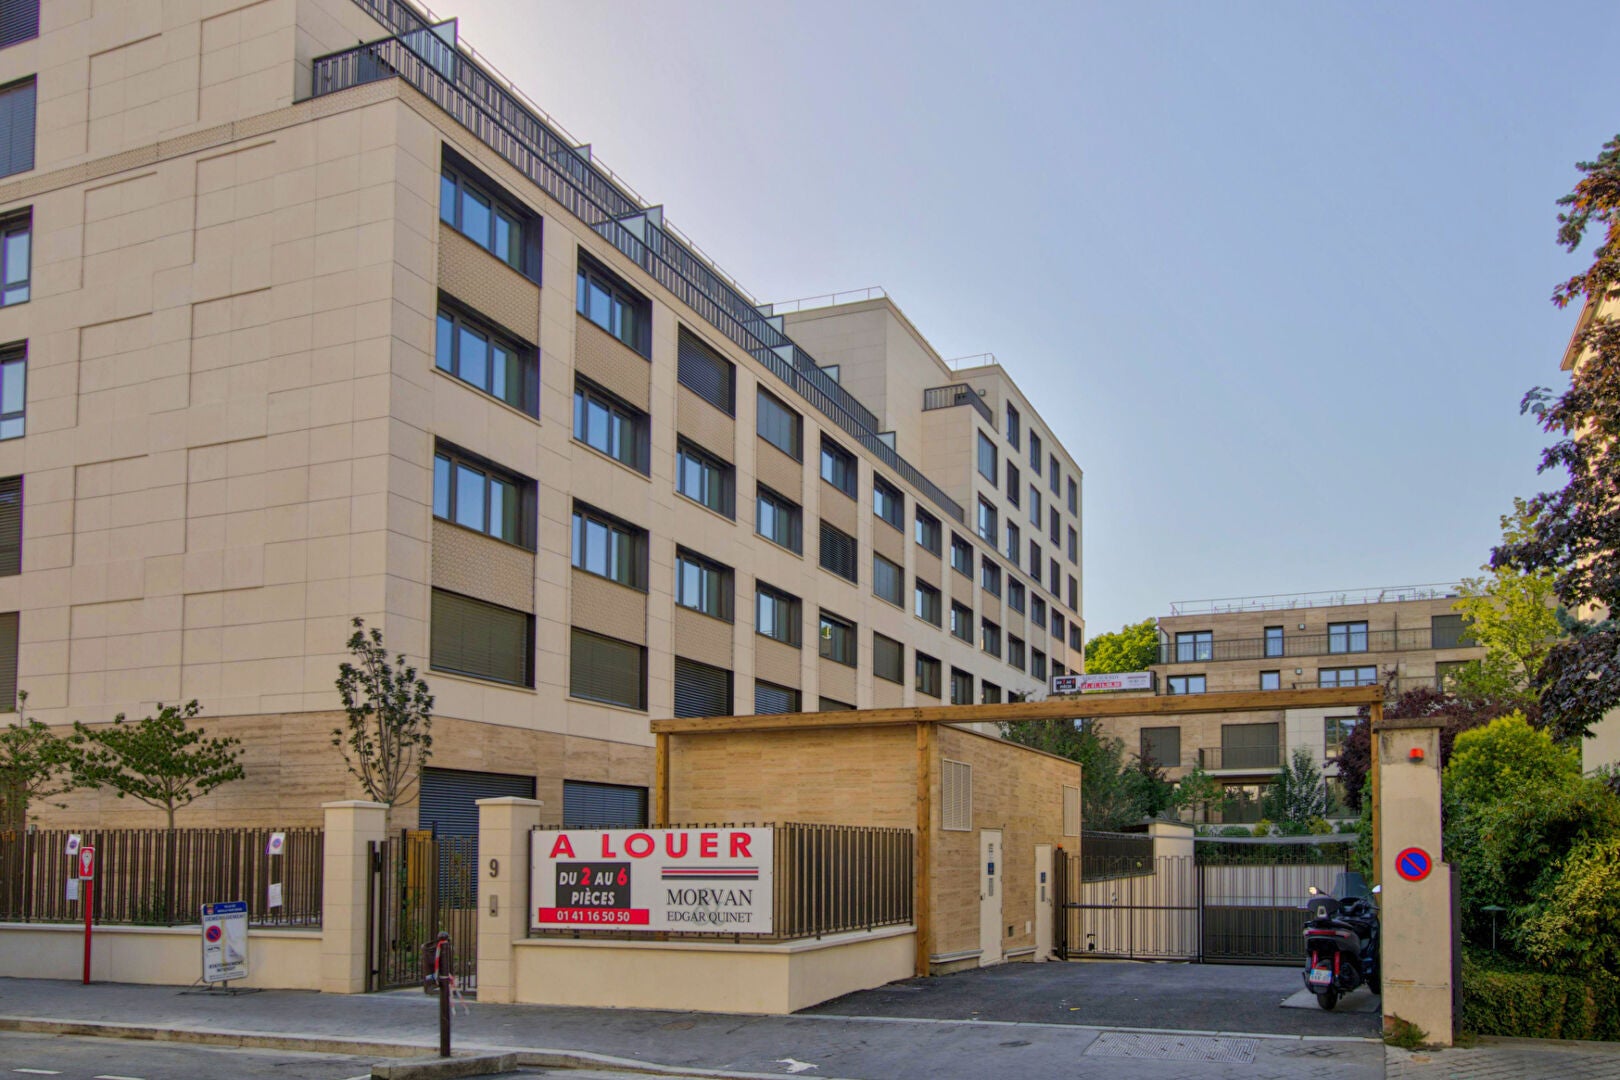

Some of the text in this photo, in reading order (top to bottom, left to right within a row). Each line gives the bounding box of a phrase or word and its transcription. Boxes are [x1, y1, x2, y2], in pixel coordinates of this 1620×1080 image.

[549, 832, 753, 859] A LOUER
[489, 858, 499, 878] 9
[559, 866, 628, 886] DU 2 AU 6
[571, 887, 615, 906] PIÈCES
[666, 888, 753, 906] MORVAN
[557, 911, 630, 922] 01 41 16 50 50
[666, 910, 753, 925] EDGAR QUINET
